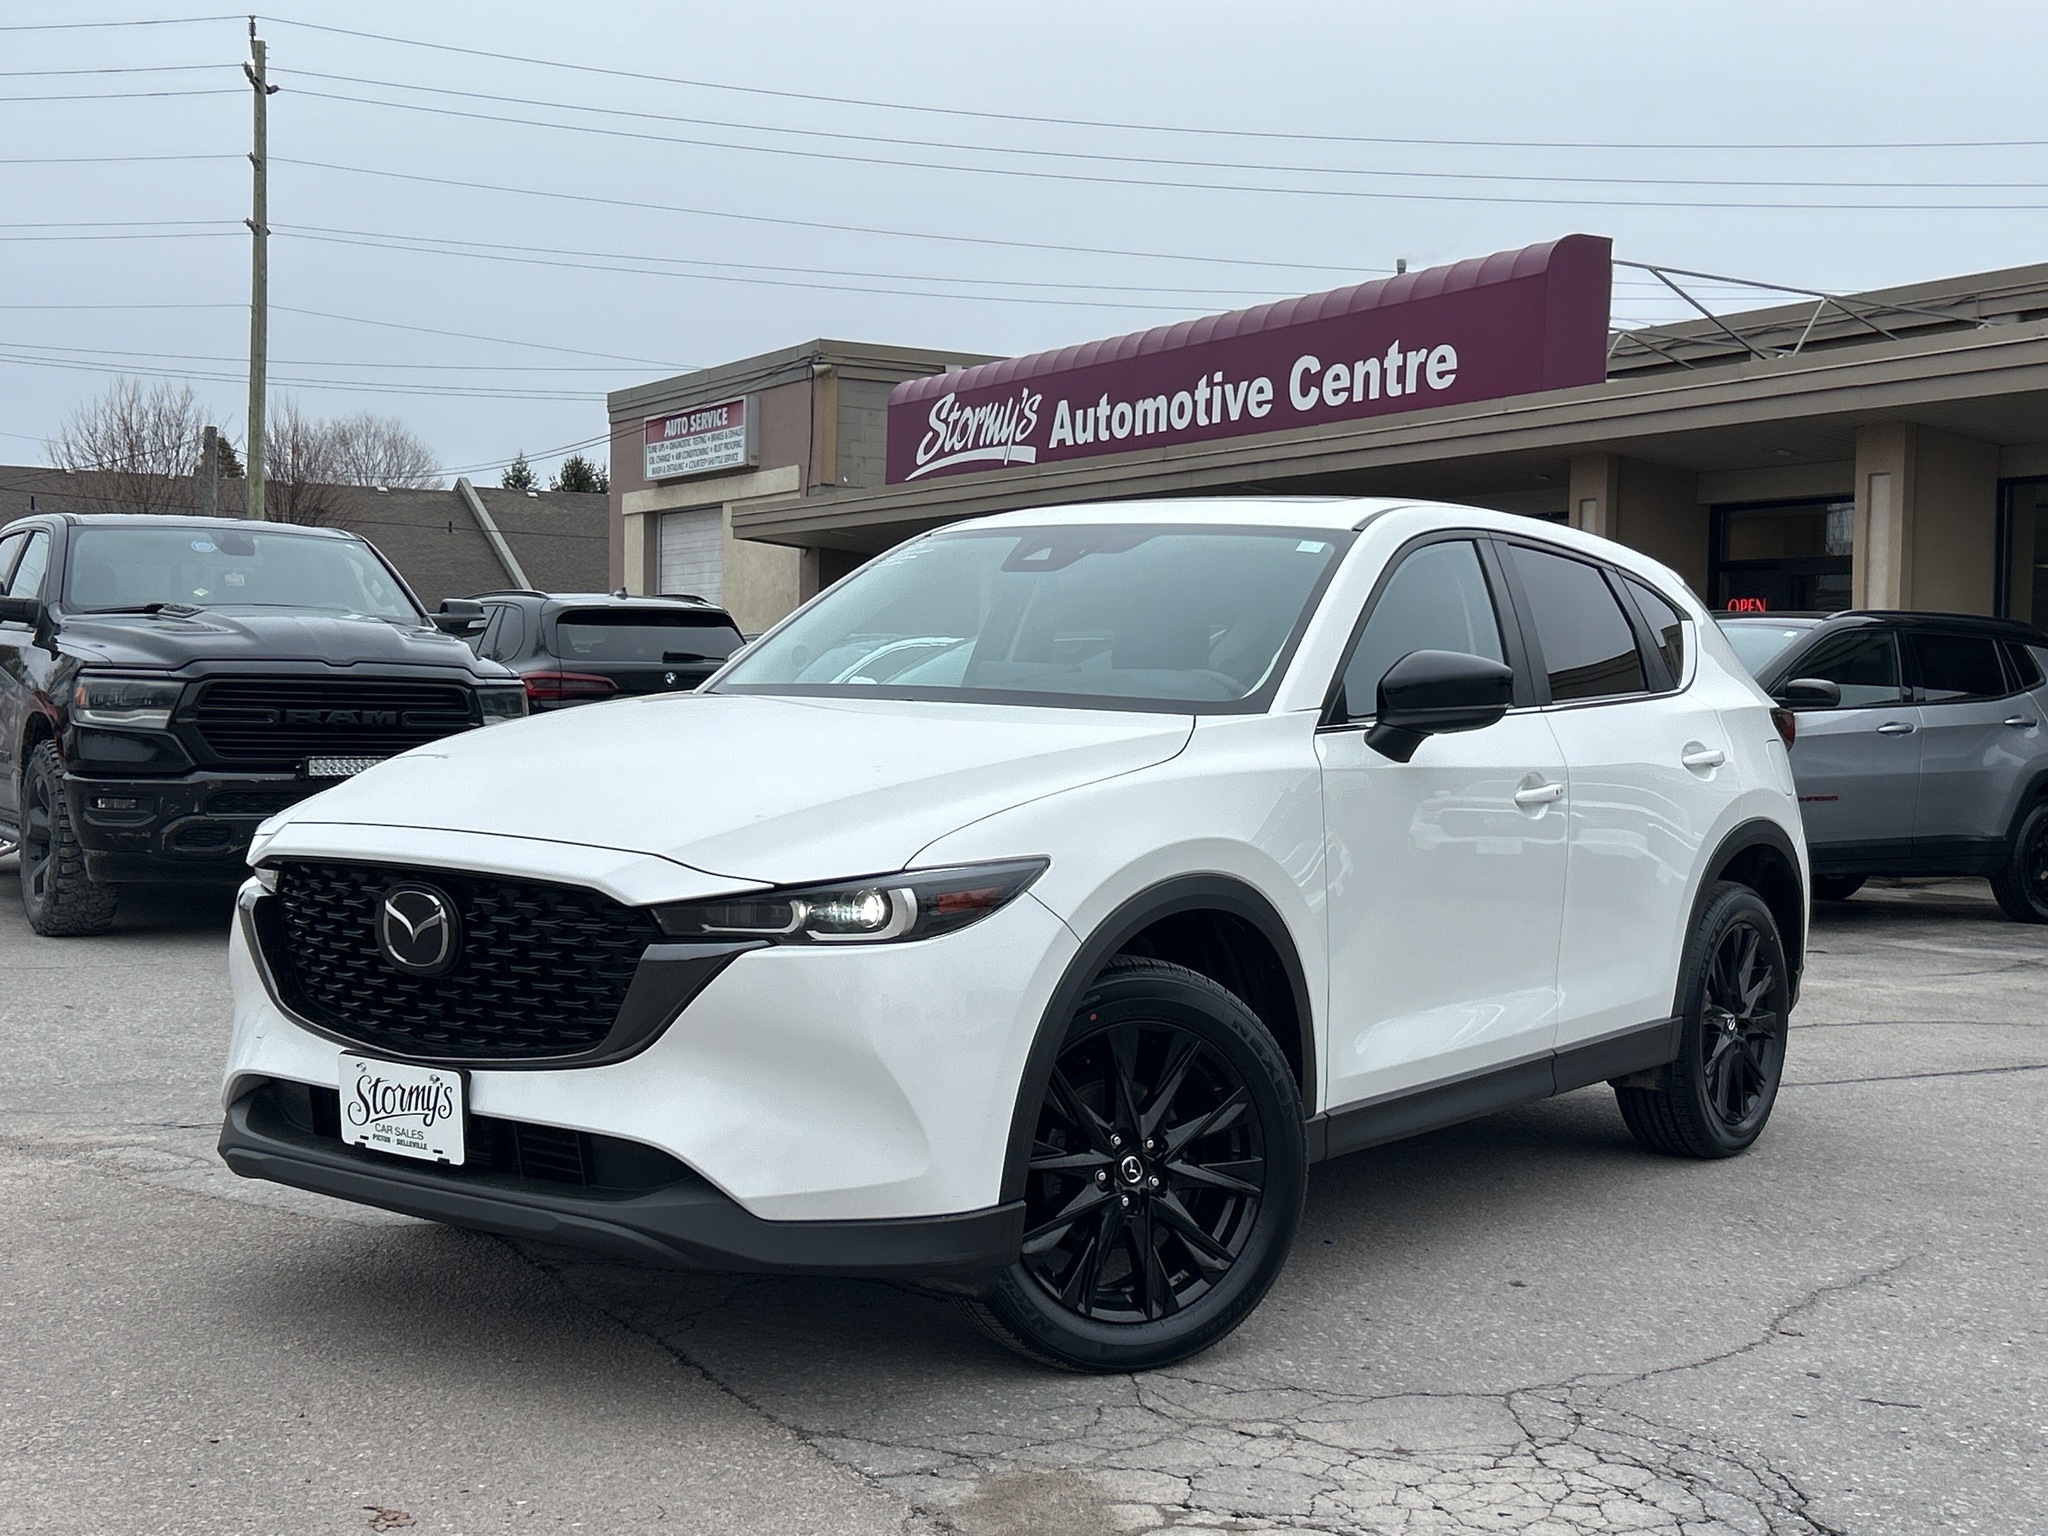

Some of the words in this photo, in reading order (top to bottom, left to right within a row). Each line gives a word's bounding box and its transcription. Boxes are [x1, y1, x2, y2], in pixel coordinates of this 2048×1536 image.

[914, 387, 1042, 468] Stormy's
[1048, 370, 1274, 449] Automotive
[1289, 339, 1458, 412] Centre
[664, 417, 688, 437] AUTO
[690, 407, 728, 432] SERVICE
[1727, 597, 1767, 612] OPEN
[285, 708, 398, 726] RAM
[347, 1074, 453, 1127] Stormy's
[374, 1122, 393, 1135] CAR
[394, 1126, 424, 1141] SALES
[372, 1133, 391, 1143] PICTON
[396, 1138, 428, 1150] BELLEVILLE
